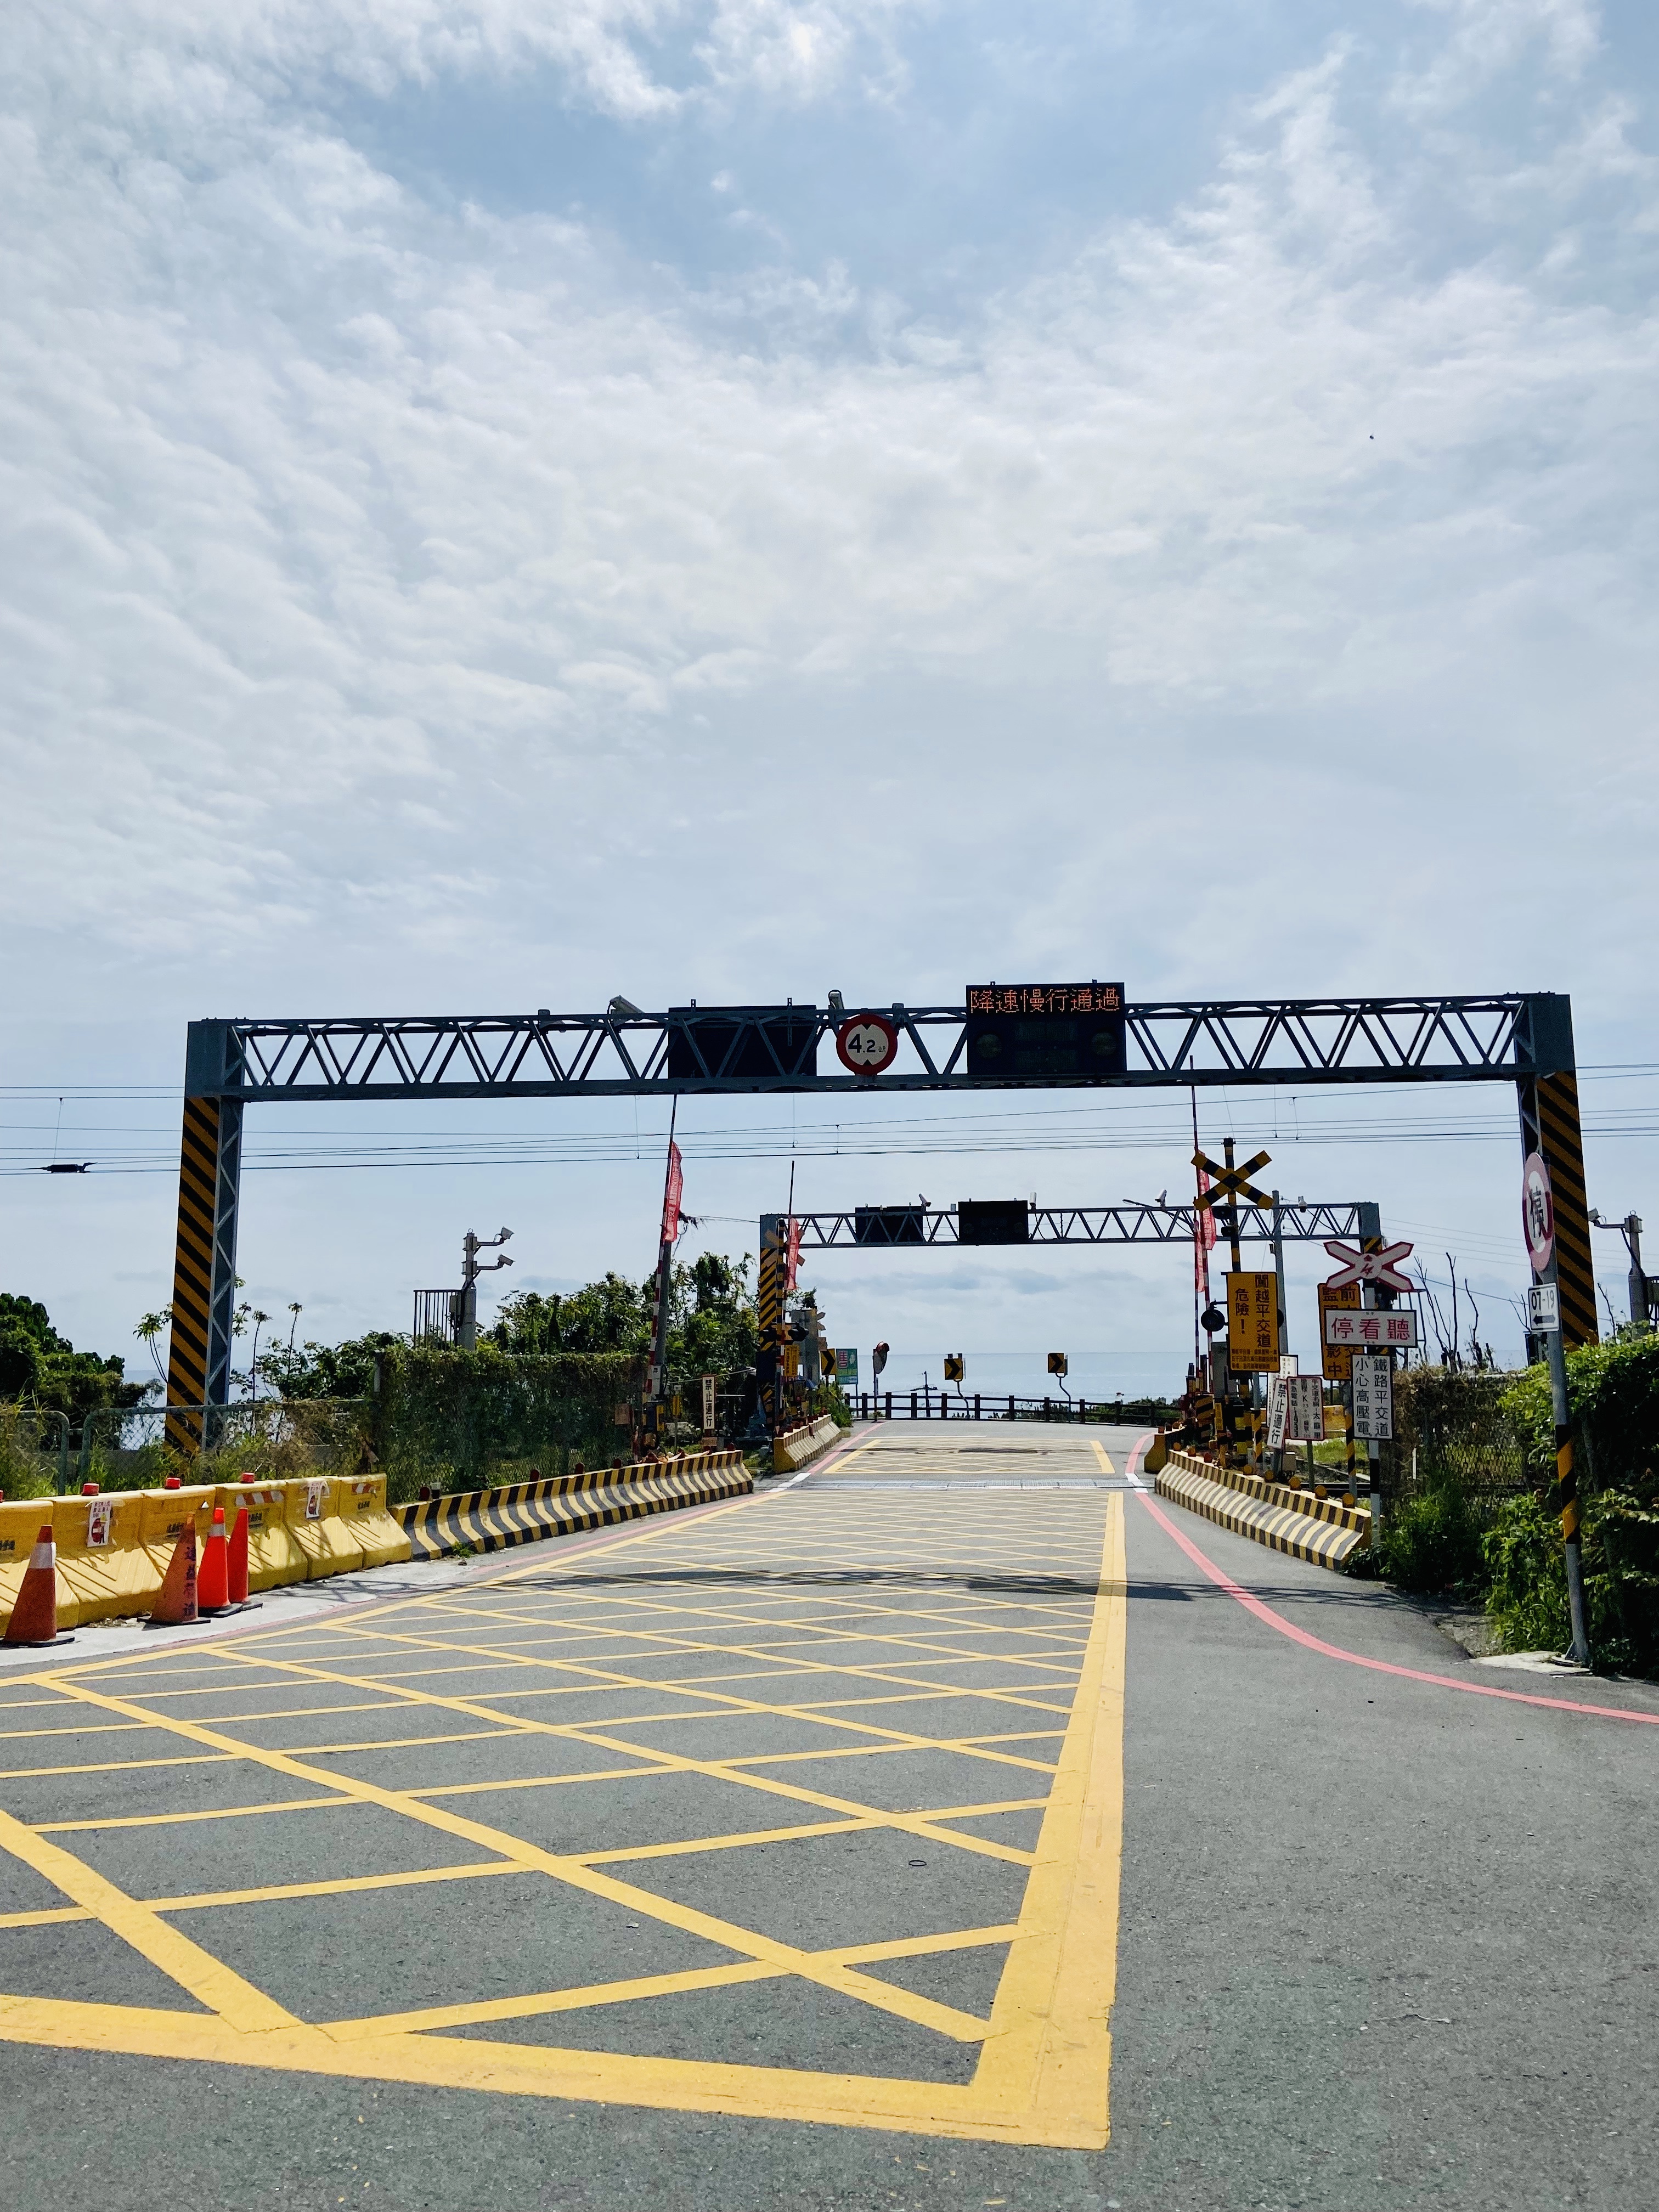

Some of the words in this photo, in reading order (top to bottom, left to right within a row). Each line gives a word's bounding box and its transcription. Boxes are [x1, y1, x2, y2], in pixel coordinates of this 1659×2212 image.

[970, 988, 1120, 1013] 降速慢行通過
[1529, 1186, 1544, 1239] 停
[1255, 1274, 1271, 1348] 闖越平交道
[1331, 1317, 1410, 1340] 停看聽
[1531, 1290, 1555, 1311] 07-19
[1271, 1383, 1286, 1444] 禁止通行
[1355, 1357, 1371, 1435] 小心高壓電
[1373, 1358, 1389, 1437] 鐵路平交道
